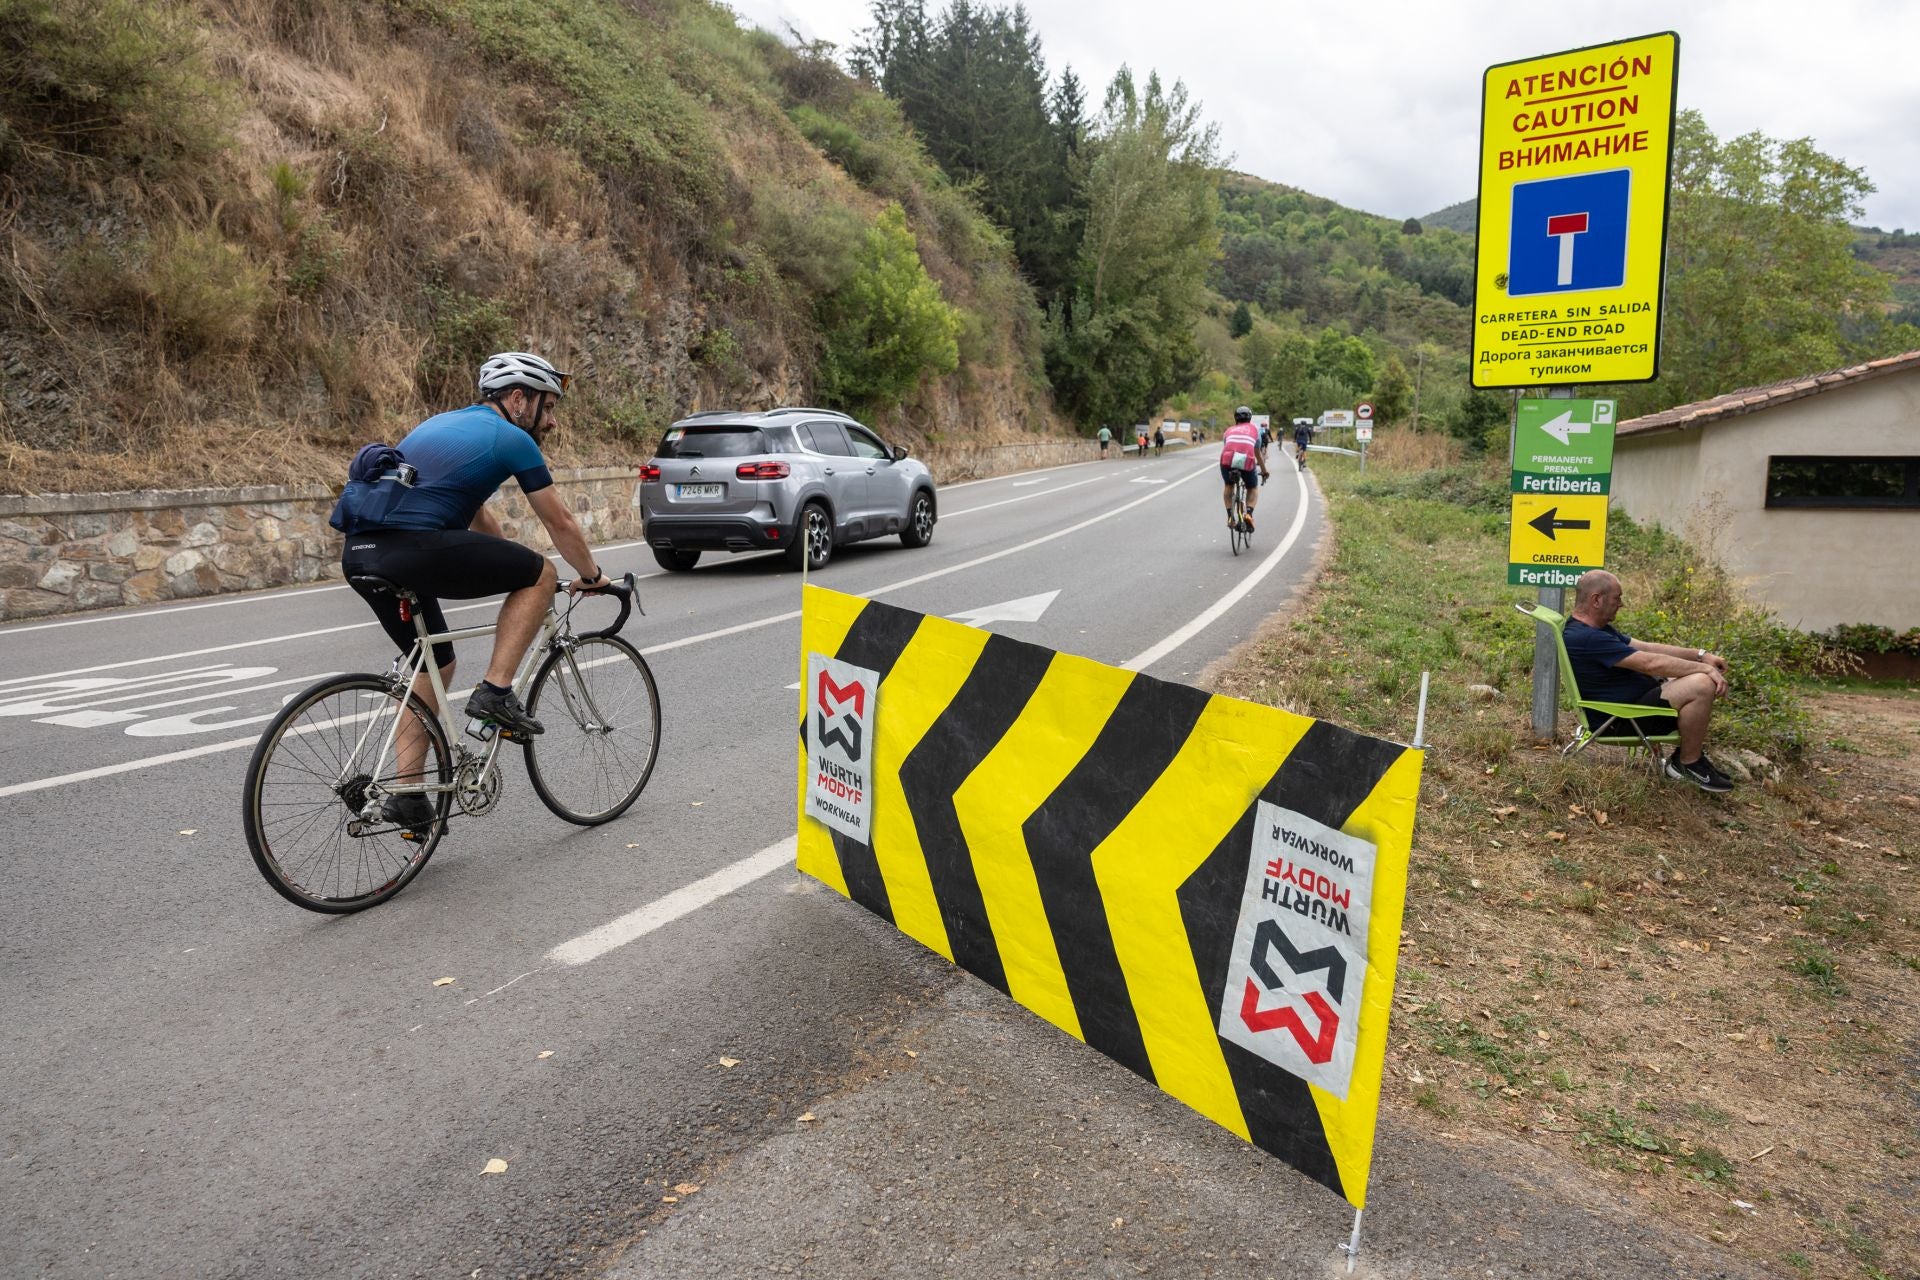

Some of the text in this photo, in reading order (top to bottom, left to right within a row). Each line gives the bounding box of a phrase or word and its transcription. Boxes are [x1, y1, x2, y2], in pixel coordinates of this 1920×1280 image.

[1505, 55, 1652, 99] ATENCIÓN
[1512, 94, 1639, 133] CAUTION
[1498, 130, 1649, 171] ВНИМАНИЕ
[1480, 302, 1651, 324] CARRETERA SIN SALIDA
[1501, 323, 1625, 341] DEAD-END ROAD
[1480, 343, 1648, 365] Дорога заканчивается
[1529, 363, 1592, 377] тупиком
[1594, 403, 1611, 422] P
[1532, 455, 1594, 464] PERMANENTE
[1543, 465, 1579, 474] PRENSA
[682, 485, 720, 495] 7246 MKR
[1523, 476, 1601, 493] Fertiberia
[1532, 554, 1580, 564] CARRERA
[819, 755, 863, 790] WÜRTH
[817, 773, 863, 805] MODYF
[815, 796, 861, 828] WORKWEAR
[1272, 824, 1354, 874] WORKWEAR
[1265, 857, 1351, 910] MODYF
[1261, 877, 1351, 936] WÜRTH
